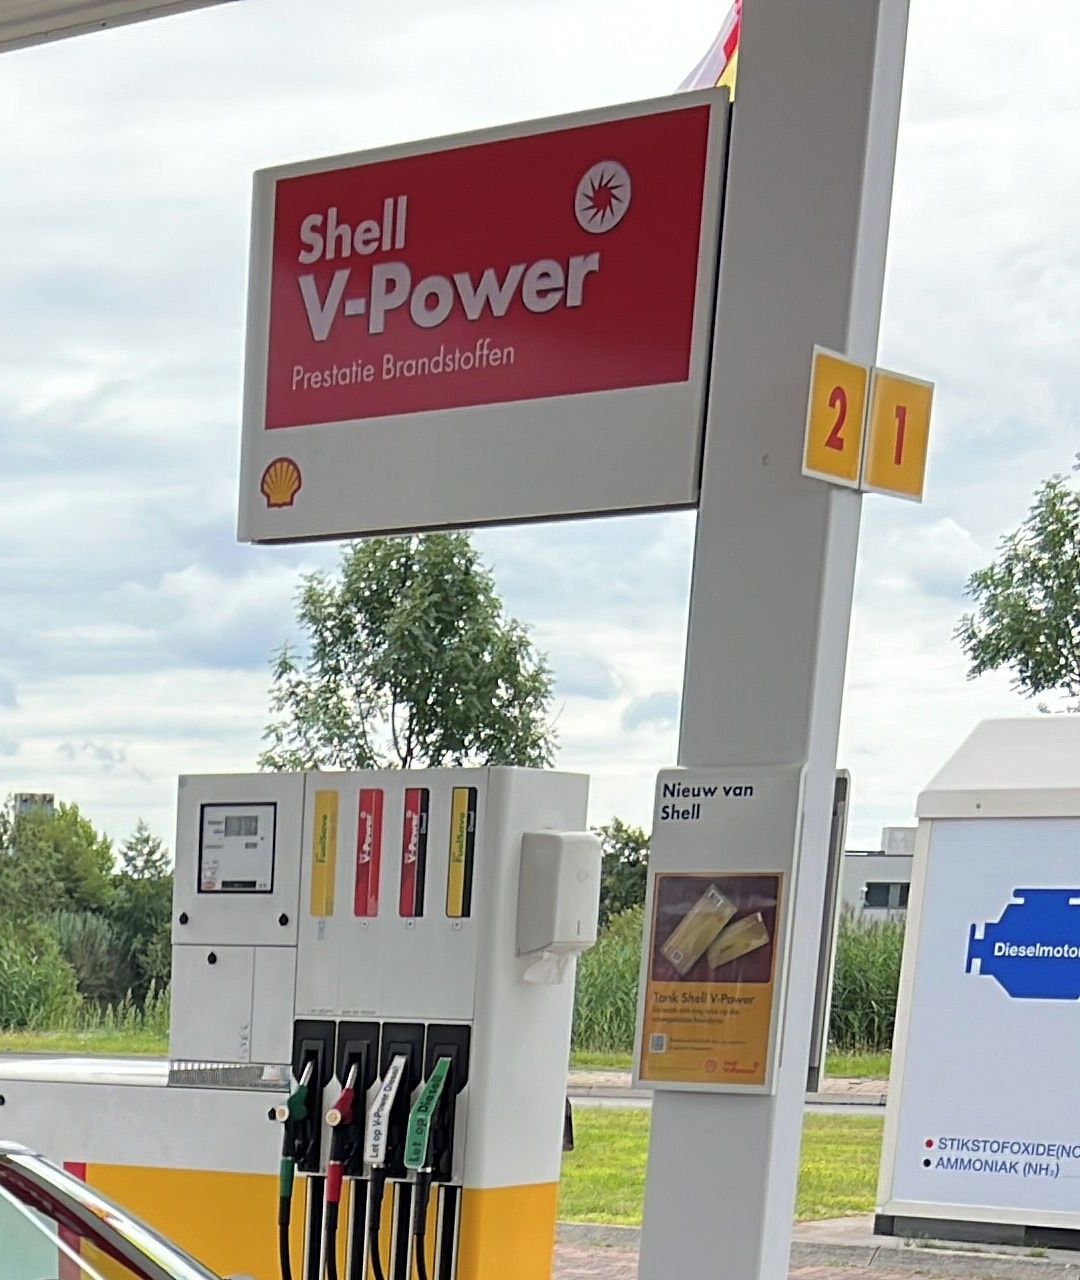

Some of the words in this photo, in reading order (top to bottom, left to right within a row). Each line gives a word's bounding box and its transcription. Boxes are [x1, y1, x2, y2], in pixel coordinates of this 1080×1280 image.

[298, 195, 408, 264] Shell
[298, 252, 600, 341] V-Power
[292, 359, 375, 390] Prestatie
[382, 338, 515, 380] Brandstoffen
[824, 386, 847, 451] 2
[893, 405, 907, 465] 1
[663, 782, 718, 798] Nieuw
[723, 786, 754, 797] van
[661, 803, 700, 820] Shell
[994, 942, 1080, 958] Dieselmoto
[654, 989, 679, 1004] Tank
[682, 990, 707, 1004] Shell
[710, 992, 755, 1005] V-Power
[373, 1129, 382, 1142] op
[408, 1141, 421, 1162] Let
[415, 1118, 427, 1135] op
[370, 1144, 379, 1158] Let
[935, 1157, 1020, 1174] AMMONIAK
